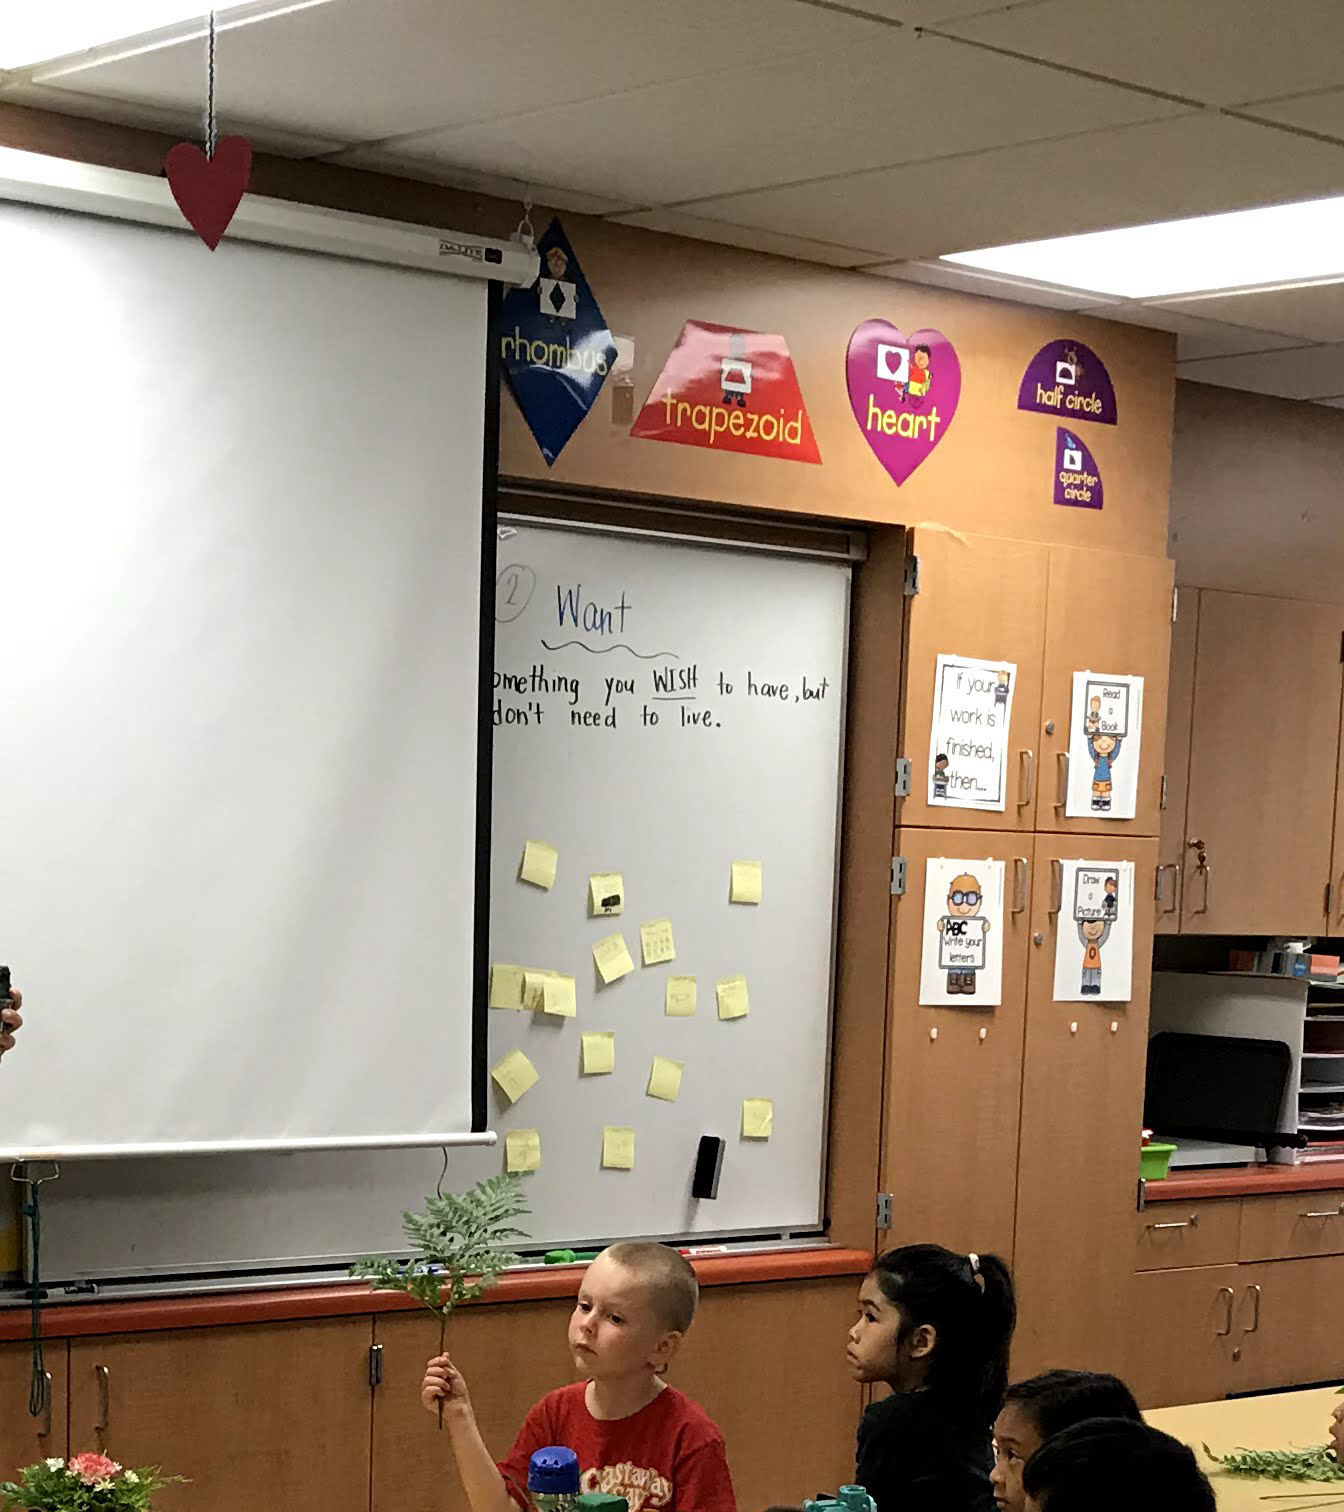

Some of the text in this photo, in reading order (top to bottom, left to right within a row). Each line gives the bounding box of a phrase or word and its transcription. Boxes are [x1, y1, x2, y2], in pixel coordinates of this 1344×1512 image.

[501, 332, 608, 379] rhombus
[1036, 382, 1103, 415] half circle
[662, 392, 803, 446] trapezoid
[867, 394, 941, 441] heart
[1059, 469, 1098, 491] quarter
[1064, 484, 1091, 503] circle
[557, 584, 632, 636] Want
[605, 676, 635, 705] you
[653, 664, 699, 693] WISH
[716, 675, 734, 697] to
[955, 671, 996, 698] If your
[1102, 687, 1122, 702] Read
[492, 698, 722, 729] don't need to live.
[949, 707, 997, 728] work is
[1101, 720, 1120, 733] Book
[945, 736, 995, 764] finished,
[947, 770, 988, 793] then...
[1081, 873, 1101, 886] Draw
[1077, 905, 1103, 918] Picture
[944, 920, 969, 937] ABC
[944, 935, 983, 952] Write your
[580, 1460, 673, 1507] Castaway
